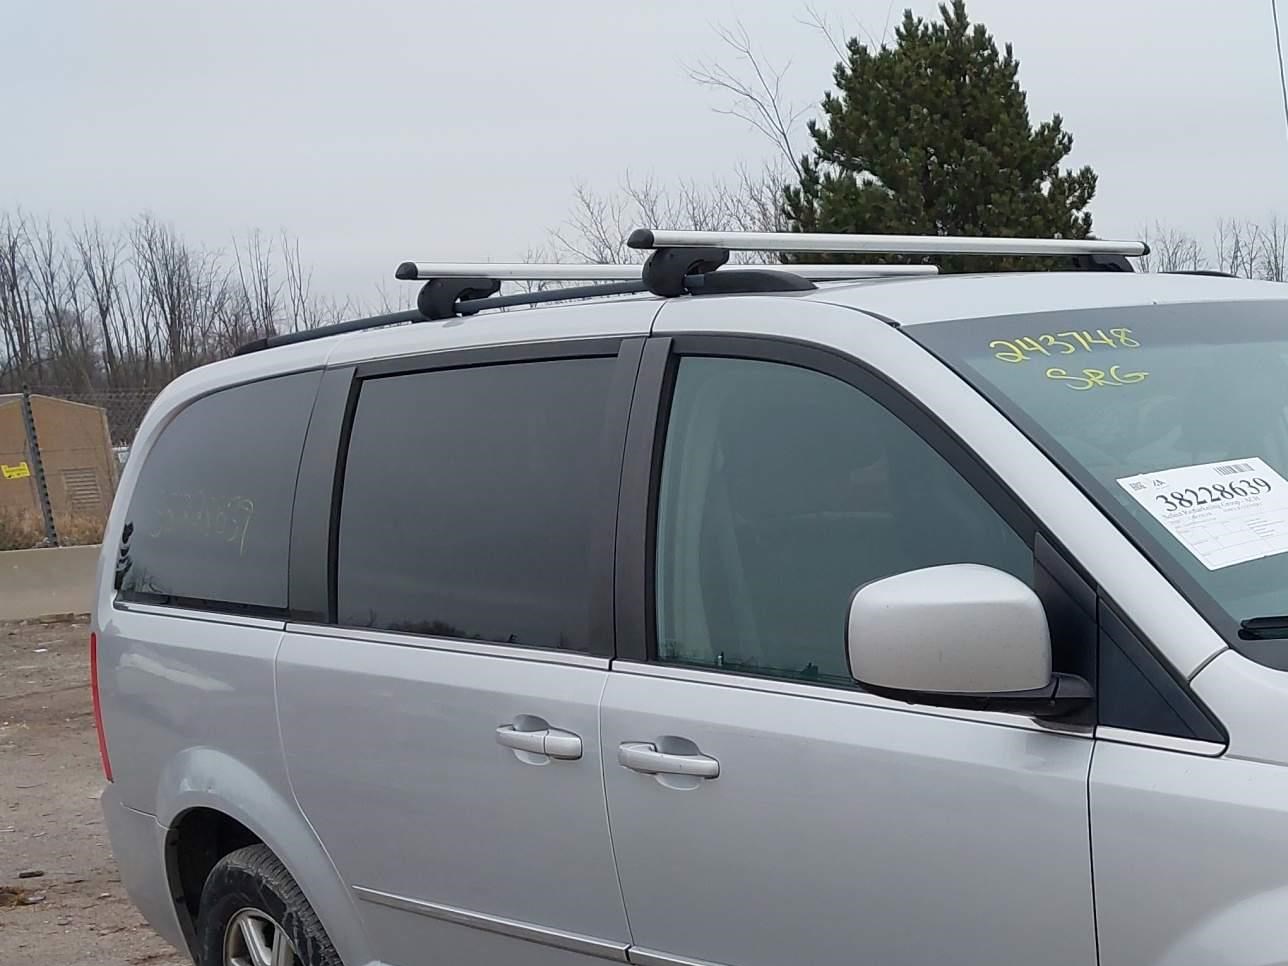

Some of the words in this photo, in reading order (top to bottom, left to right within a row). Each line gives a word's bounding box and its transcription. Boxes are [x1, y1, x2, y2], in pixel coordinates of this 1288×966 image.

[990, 327, 1140, 363] 243748
[1046, 365, 1149, 390] SRG
[1156, 477, 1271, 512] 38228639
